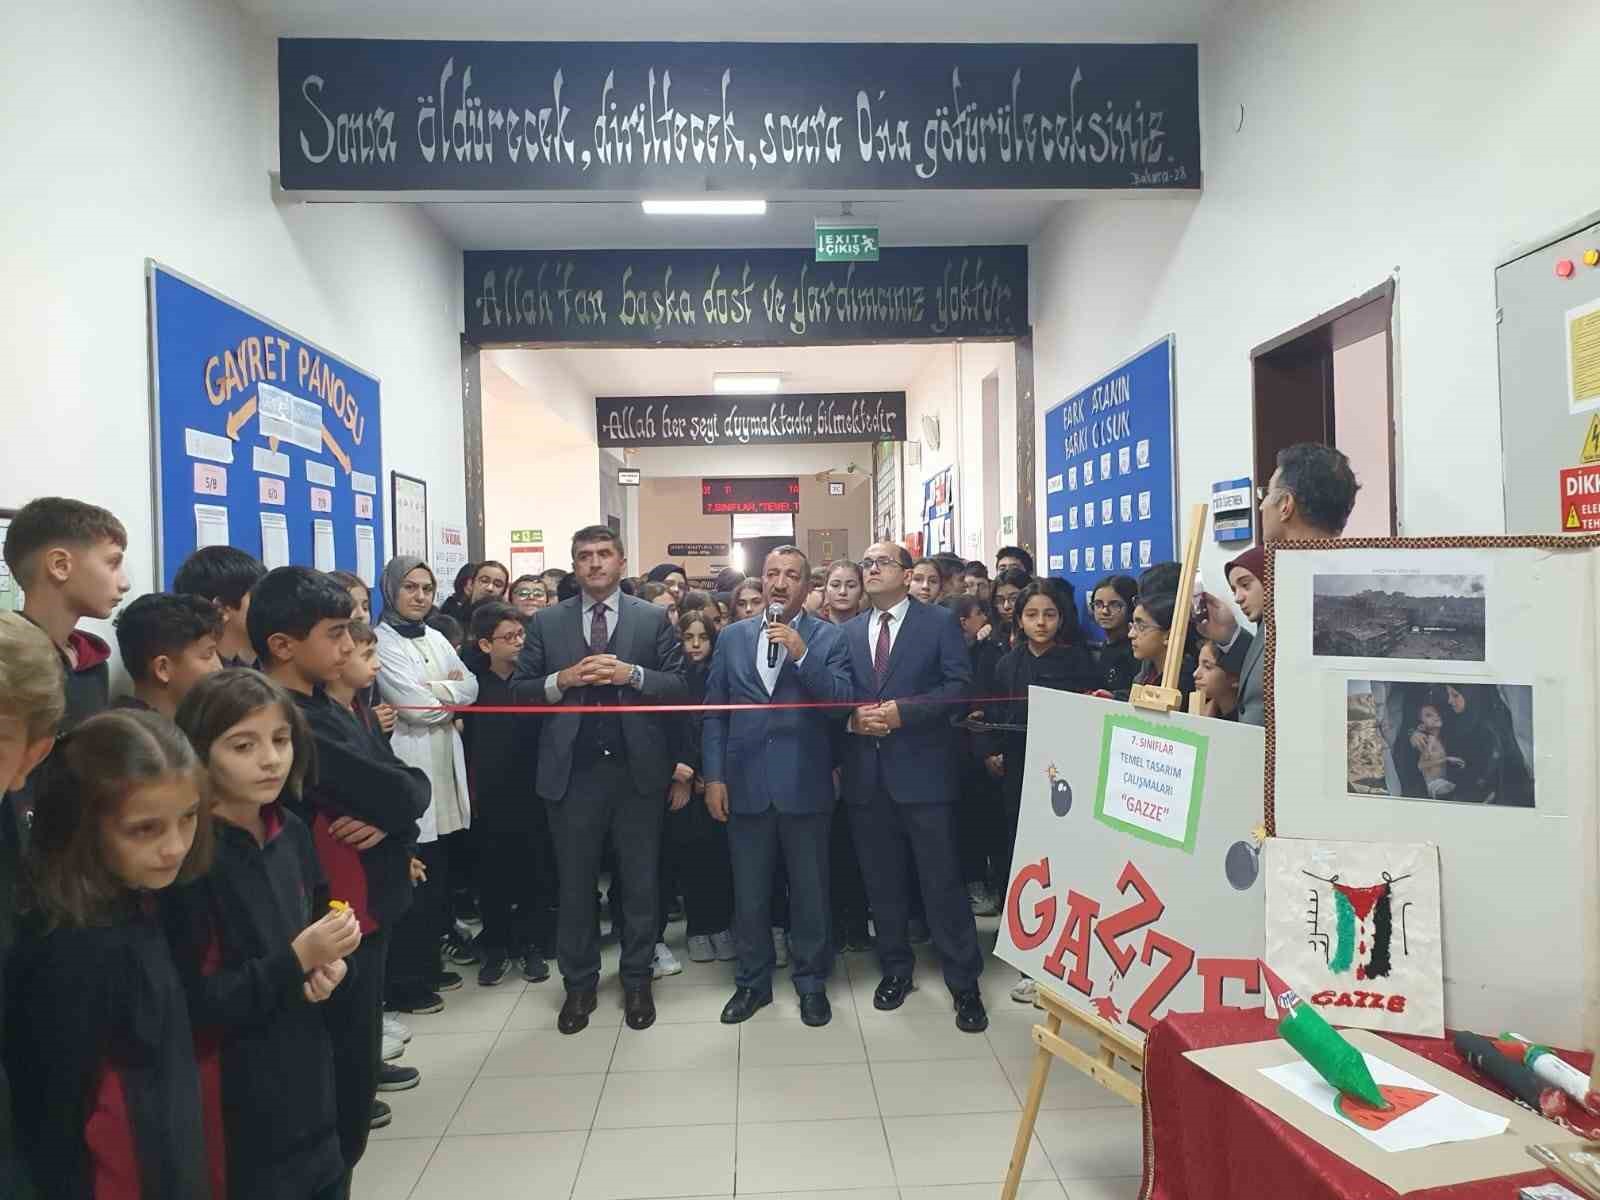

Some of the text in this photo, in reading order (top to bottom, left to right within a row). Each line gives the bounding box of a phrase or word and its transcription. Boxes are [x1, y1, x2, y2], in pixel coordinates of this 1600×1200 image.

[300, 74, 397, 164] Sonra
[760, 104, 844, 164] sonra
[825, 234, 860, 245] EXIT
[825, 244, 860, 256] ÇIKIŞ
[618, 264, 697, 330] başka
[702, 259, 757, 326] dost
[763, 274, 787, 324] ve
[298, 346, 365, 446] PANOSU
[602, 404, 657, 440] Allah
[661, 403, 687, 439] her
[1139, 737, 1174, 755] SINIFLAR
[1120, 752, 1182, 778] TEMEL TASARIM
